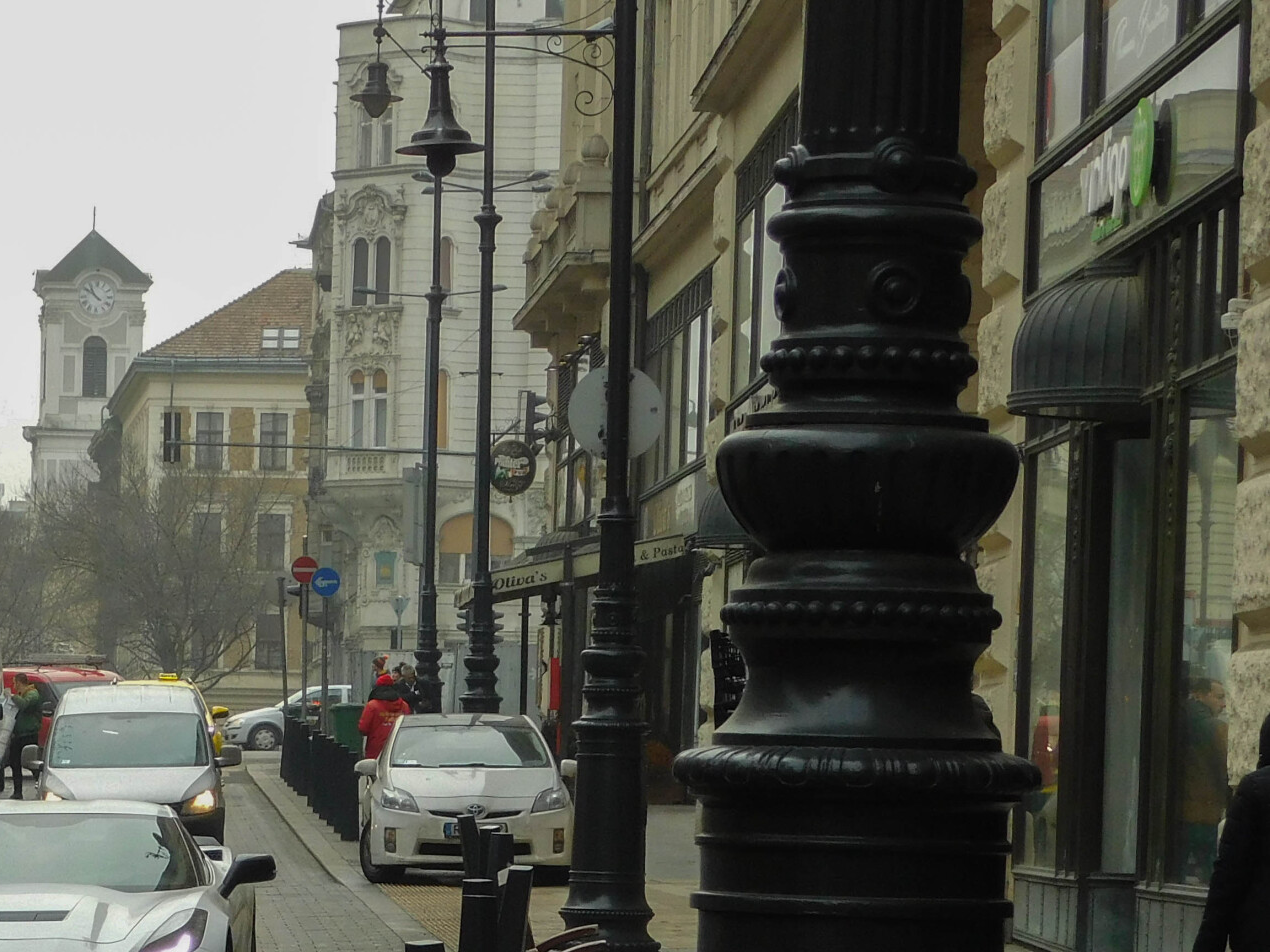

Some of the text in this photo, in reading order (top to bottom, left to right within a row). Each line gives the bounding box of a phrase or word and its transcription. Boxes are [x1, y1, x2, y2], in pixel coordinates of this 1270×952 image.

[639, 544, 685, 561] & Pasta
[493, 571, 548, 590] Oliva's
